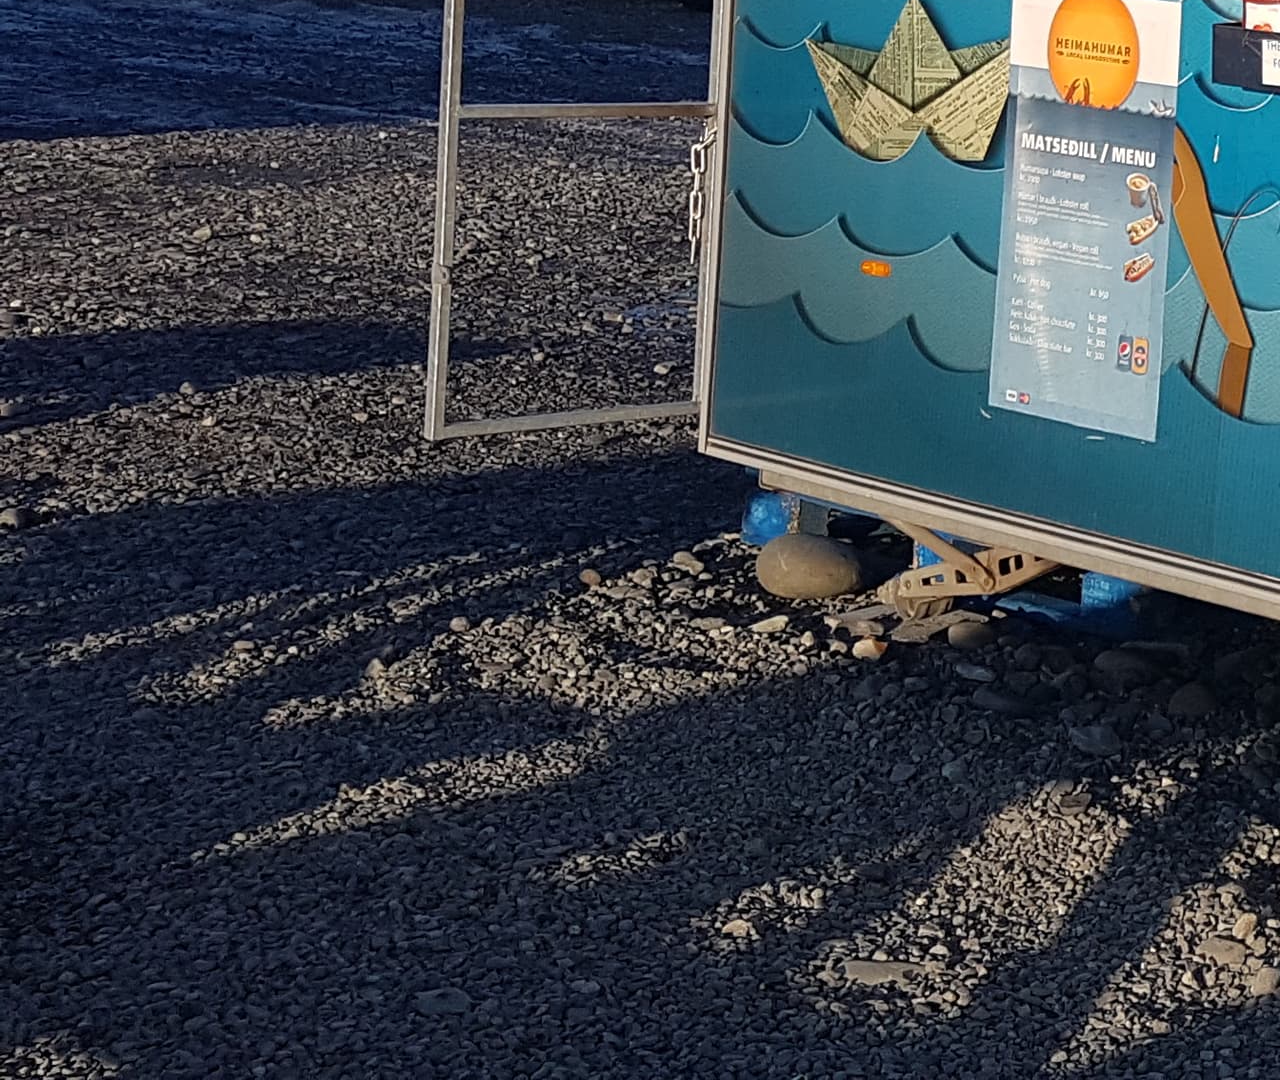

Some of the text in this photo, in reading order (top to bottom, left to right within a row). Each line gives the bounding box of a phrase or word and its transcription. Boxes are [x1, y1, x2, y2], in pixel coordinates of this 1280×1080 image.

[1056, 37, 1131, 57] HEIMAHUMAR
[1021, 132, 1097, 159] MATSEÐILL
[1111, 146, 1157, 168] MENU
